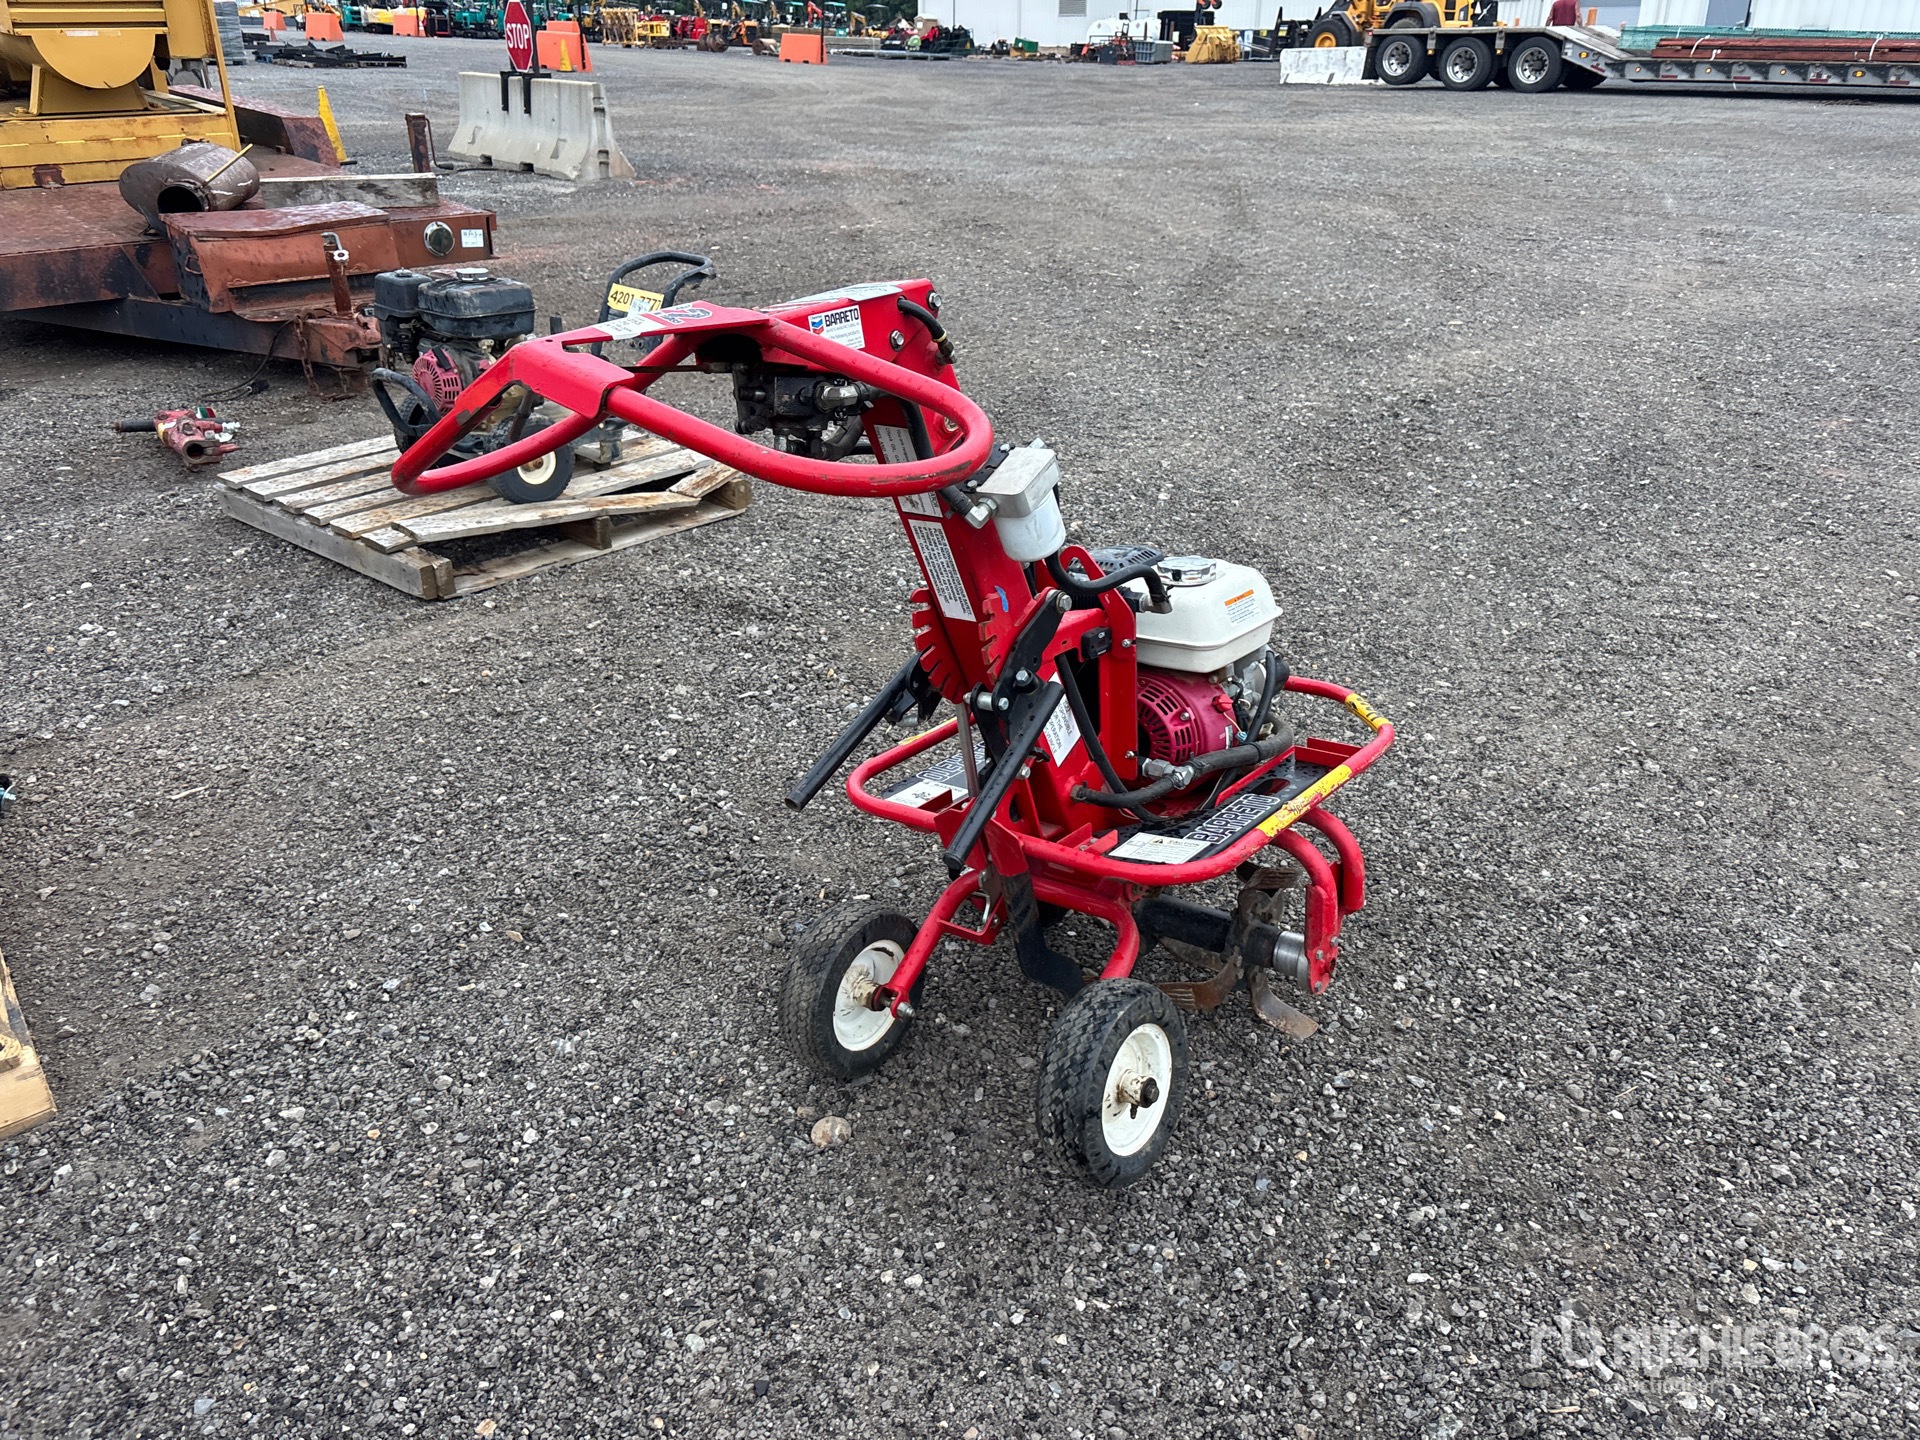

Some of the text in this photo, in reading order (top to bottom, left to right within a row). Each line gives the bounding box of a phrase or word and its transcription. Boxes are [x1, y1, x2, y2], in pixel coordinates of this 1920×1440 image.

[506, 22, 529, 49] STOP
[610, 290, 634, 305] 4201
[824, 308, 860, 327] BARRETO
[917, 526, 927, 543] SAFETY
[918, 542, 926, 554] CALL
[932, 527, 942, 545] PLEASE
[939, 546, 947, 559] READ
[924, 531, 933, 546] THERE
[936, 562, 944, 577] DOUBT
[931, 537, 939, 550] OBEY
[940, 560, 949, 578] SAFETY
[944, 547, 957, 575] CONCERNED
[1183, 793, 1281, 845] BARRETO
[1166, 839, 1201, 849] CAUTION
